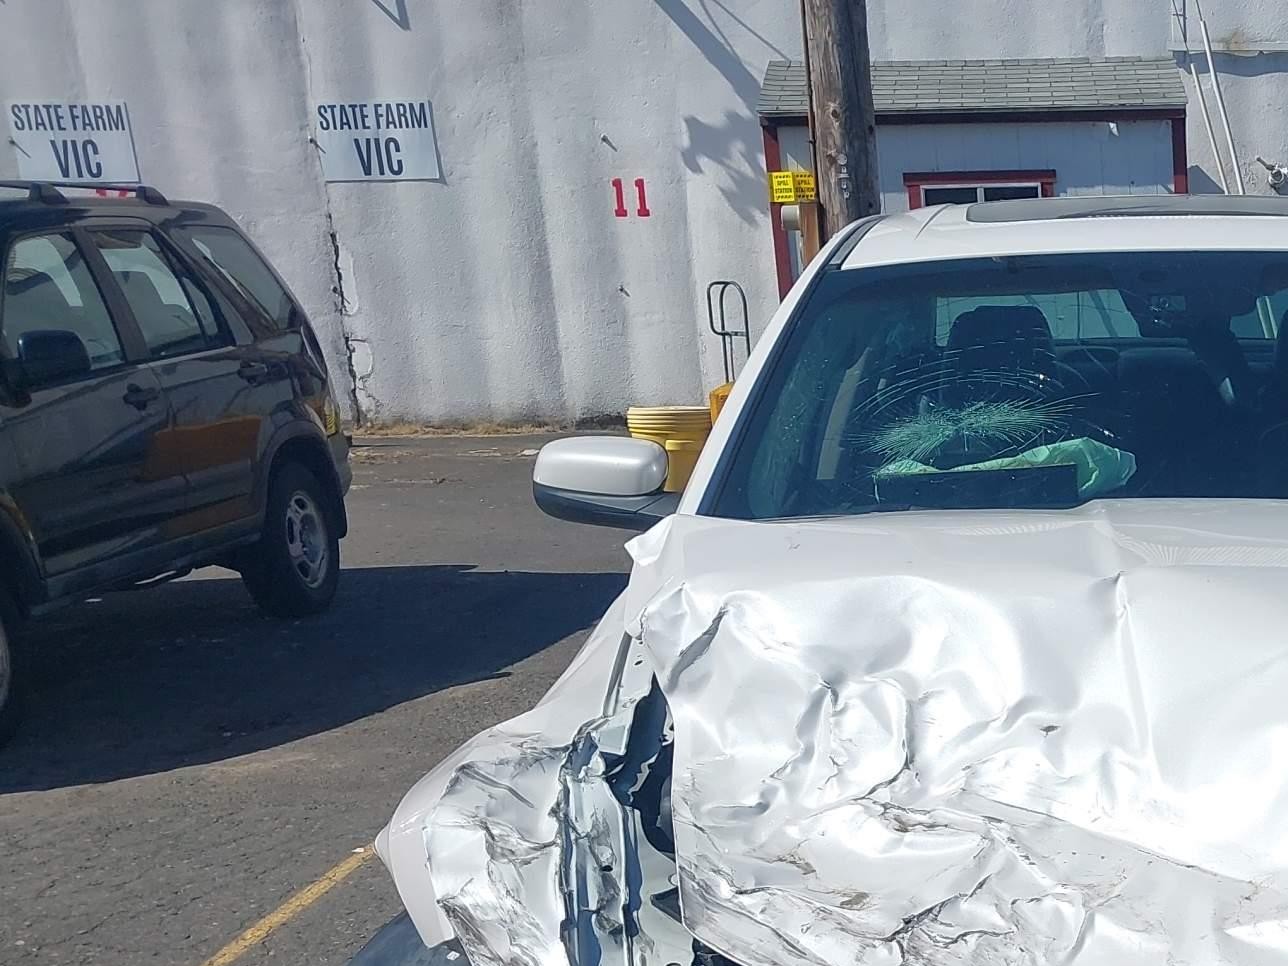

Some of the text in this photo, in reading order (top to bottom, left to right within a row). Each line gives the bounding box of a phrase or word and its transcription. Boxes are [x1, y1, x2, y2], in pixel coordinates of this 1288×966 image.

[11, 104, 126, 131] STATE FARM
[317, 102, 429, 130] STATE FARM
[50, 138, 103, 178] VIC
[353, 137, 404, 176] VIC
[611, 178, 651, 218] 11
